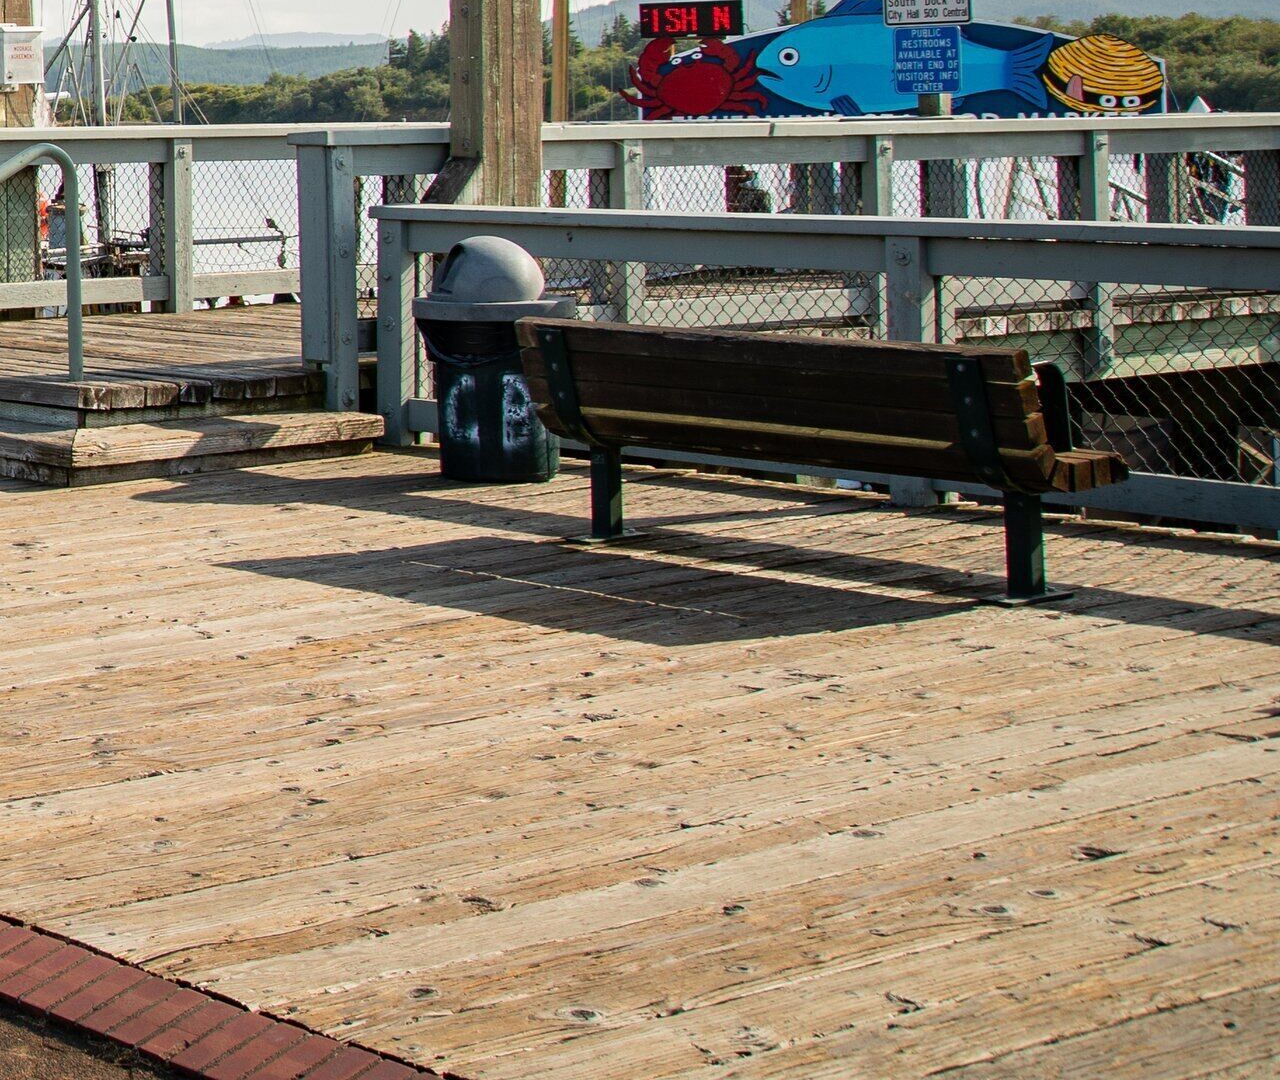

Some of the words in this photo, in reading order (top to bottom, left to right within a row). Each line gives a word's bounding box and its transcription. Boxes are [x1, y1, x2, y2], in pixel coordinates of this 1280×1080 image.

[713, 6, 731, 30] N
[888, 9, 902, 21] City
[906, 9, 920, 19] Hall
[924, 8, 939, 18] 500
[942, 7, 968, 17] Central
[911, 29, 941, 38] PUBLIC
[901, 38, 951, 48] RESTROOMS
[898, 49, 941, 59] AVAILABLE
[946, 49, 956, 58] AT
[896, 61, 923, 70] NORTH
[928, 60, 944, 69] END
[948, 59, 959, 69] OF
[896, 71, 935, 81] VISITORS
[940, 70, 959, 80] INFO
[912, 82, 944, 92] CENTER
